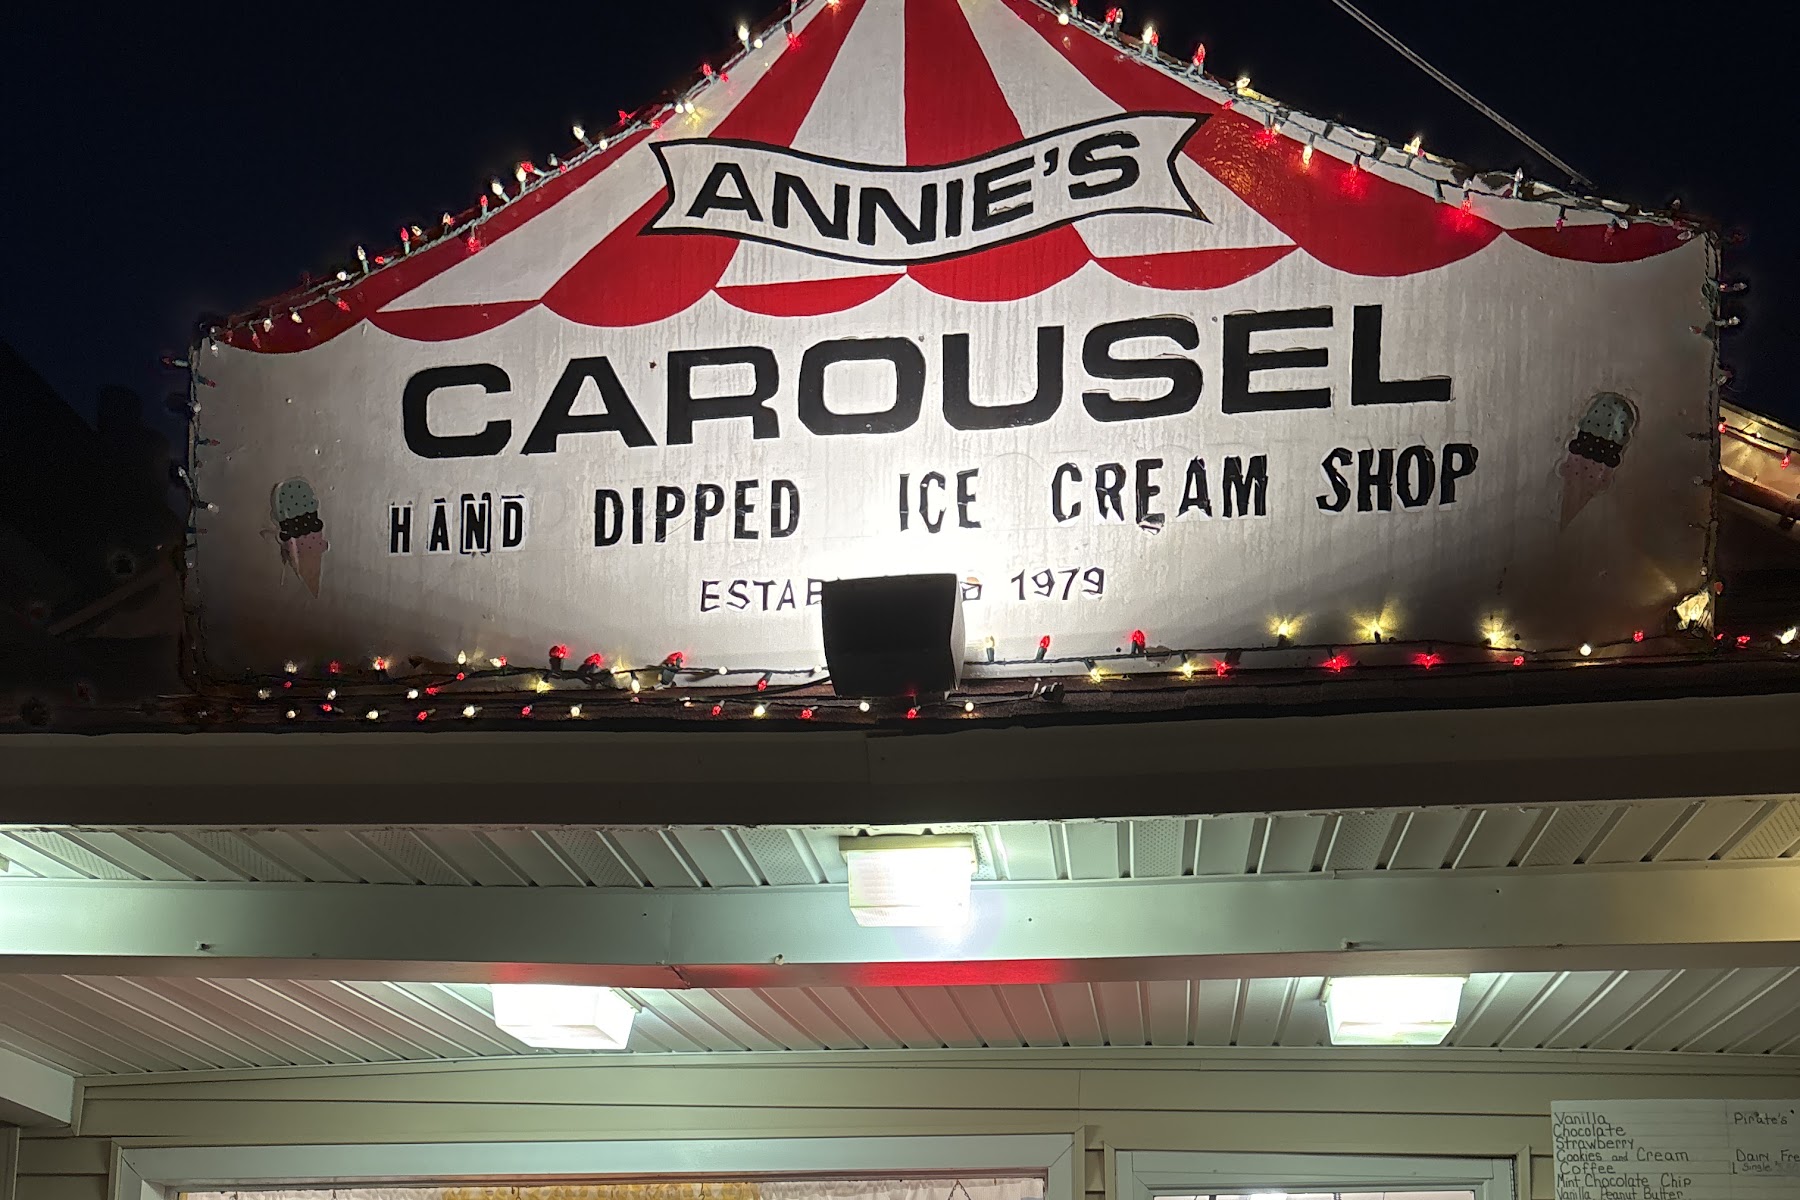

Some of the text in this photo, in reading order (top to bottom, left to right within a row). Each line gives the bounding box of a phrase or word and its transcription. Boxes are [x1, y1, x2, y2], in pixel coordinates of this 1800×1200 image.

[685, 131, 1140, 247] ANNIE'S
[402, 304, 1452, 460] CAROUSEL
[389, 443, 1478, 554] HAND DIPPED ICE CREAM SHOP
[1012, 568, 1105, 601] 1979
[1554, 1111, 1608, 1125] Vanilla
[1734, 1112, 1788, 1125] Pirate's
[1553, 1123, 1626, 1137] Chocolate
[1556, 1136, 1634, 1150] Strawberry
[1556, 1149, 1602, 1162] Cookies
[1637, 1147, 1689, 1161] Cream
[1781, 1149, 1800, 1161] Fre
[1560, 1161, 1616, 1175] Coffee
[1557, 1173, 1692, 1188] Mint Chocolate Chip
[1556, 1186, 1683, 1200] Vanilla Peanut Butter
